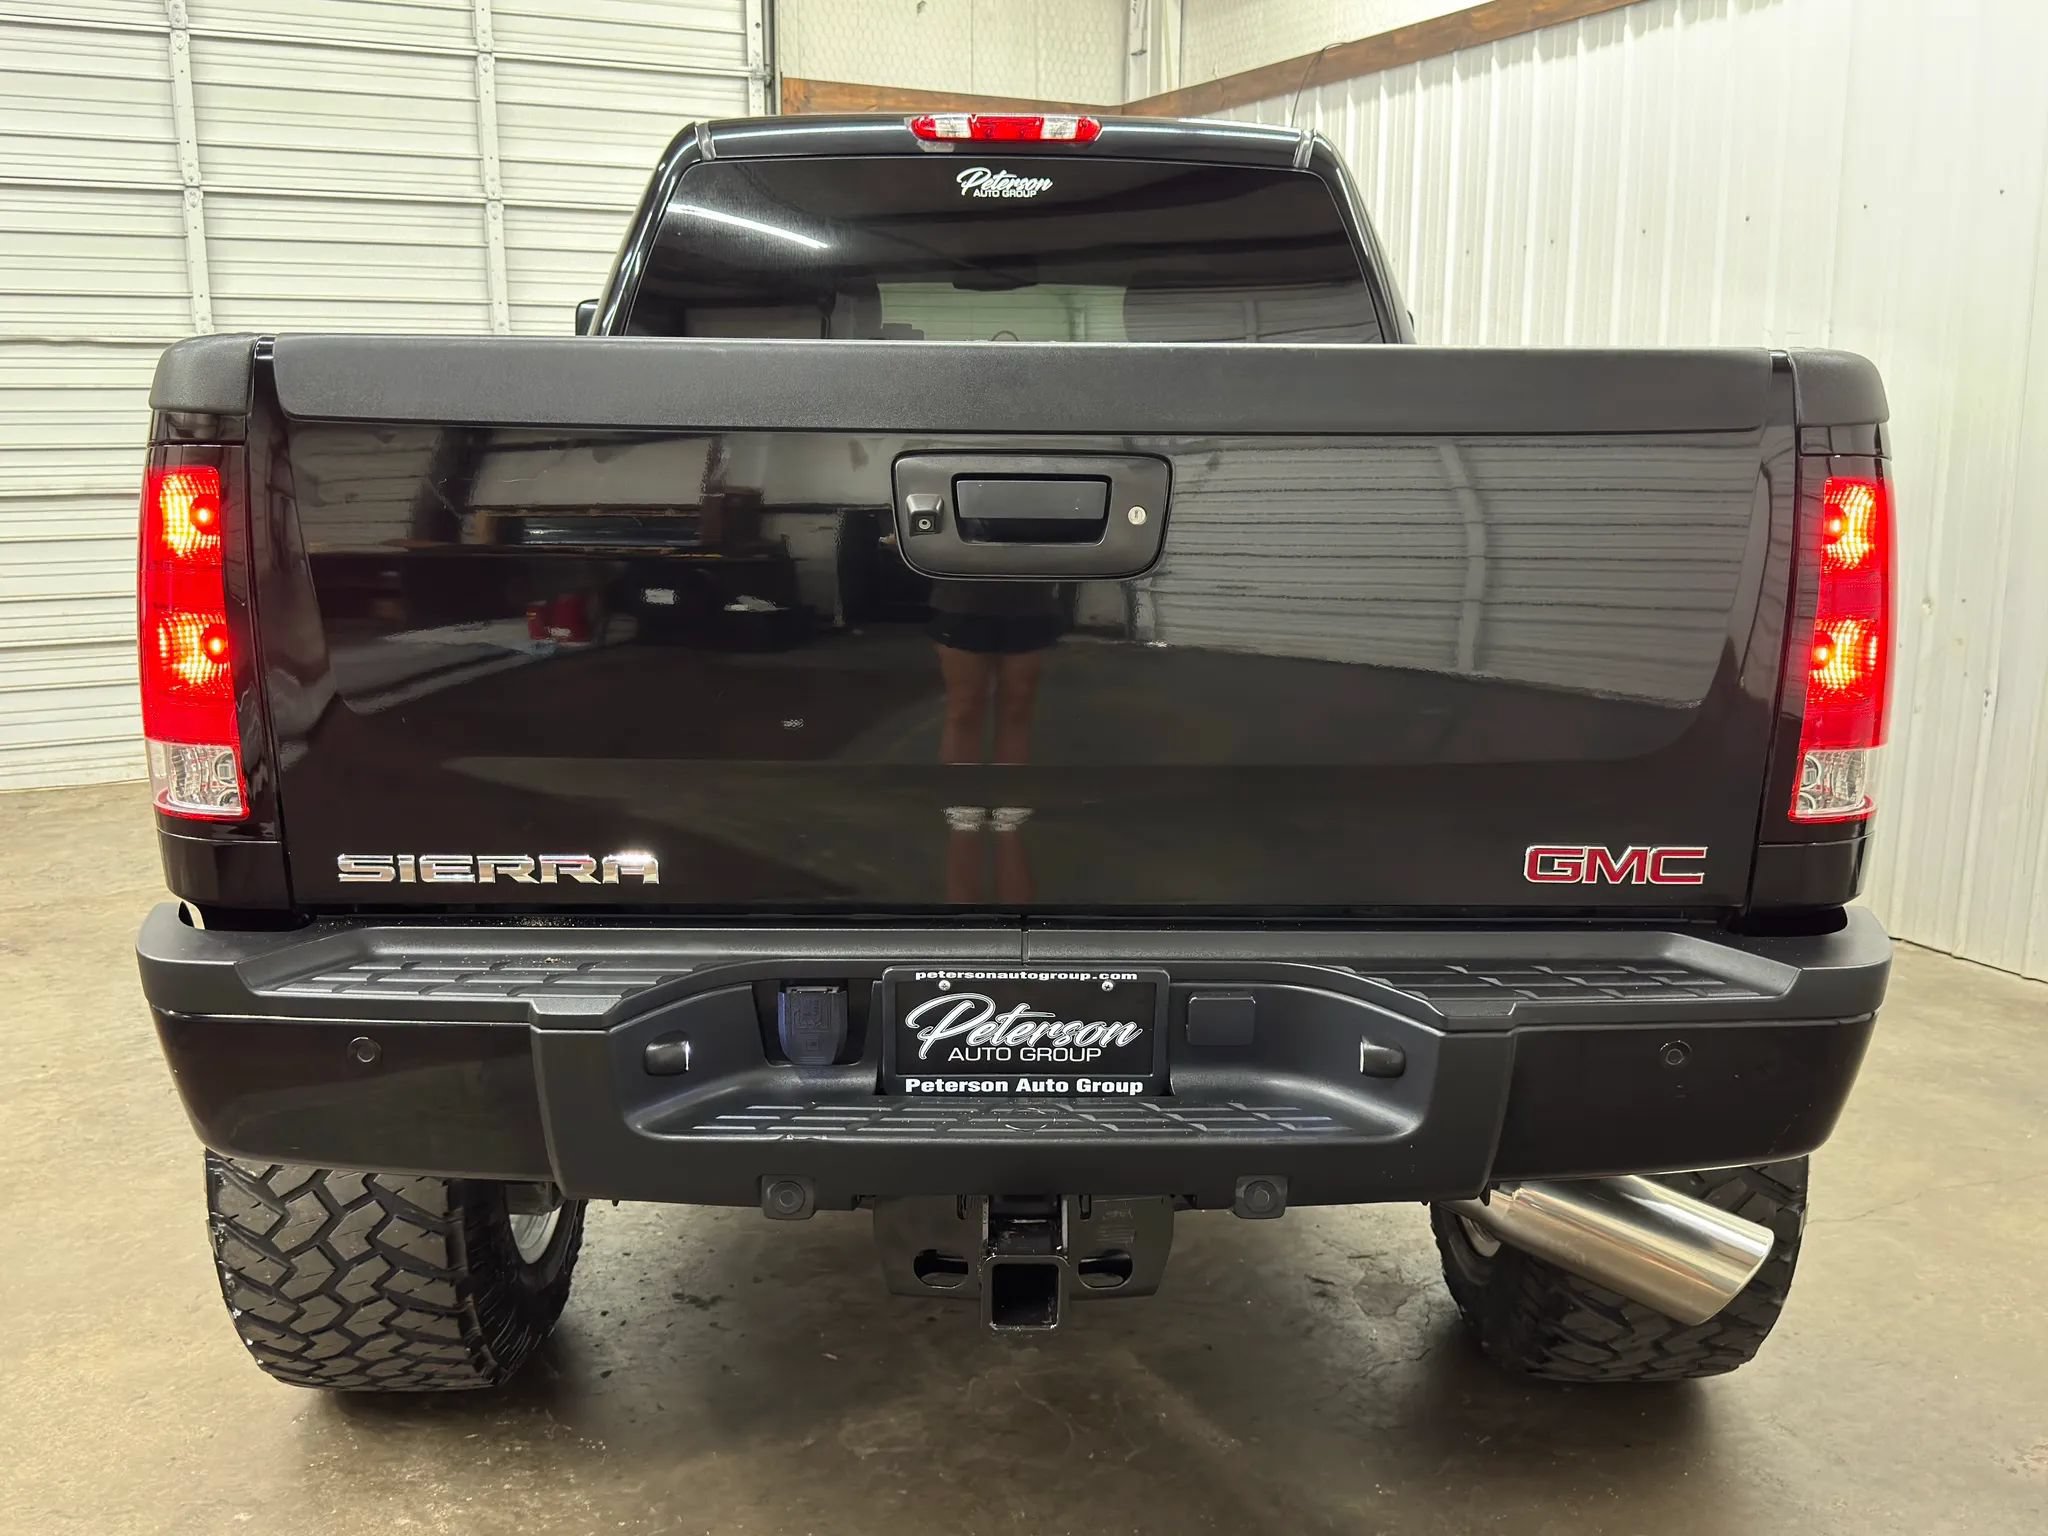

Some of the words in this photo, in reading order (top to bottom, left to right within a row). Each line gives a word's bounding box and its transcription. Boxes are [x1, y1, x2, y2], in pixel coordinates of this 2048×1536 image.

[956, 167, 1053, 195] Peterson
[973, 189, 1000, 197] AUTO
[1001, 189, 1037, 197] GROUP
[337, 853, 660, 884] SIERRA
[1524, 845, 1708, 884] GMC
[915, 970, 1138, 981] petersonautogroup.com
[904, 992, 1142, 1060] Peterson
[948, 1047, 1012, 1062] AUTO
[1019, 1047, 1102, 1062] GROUP
[905, 1078, 1009, 1093] Peterson
[1015, 1078, 1069, 1093] Auto
[1076, 1078, 1144, 1095] Group
